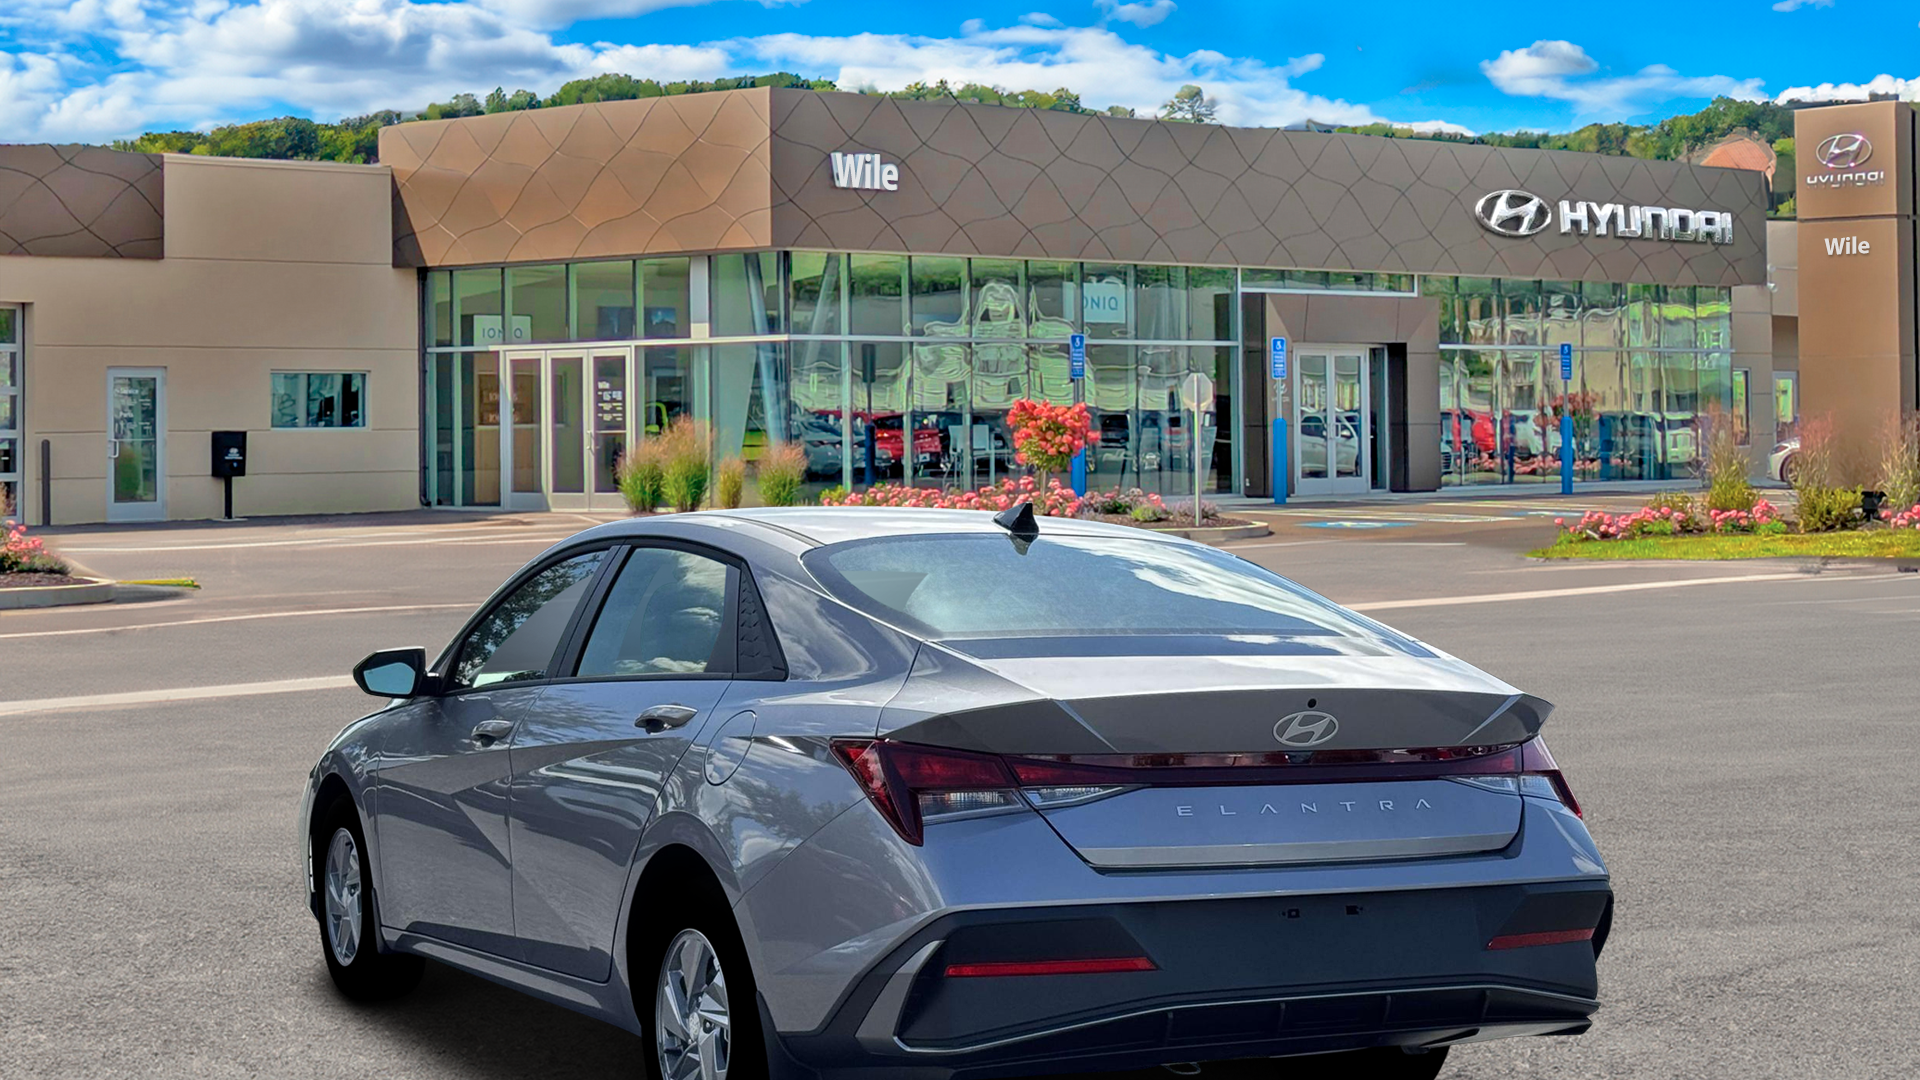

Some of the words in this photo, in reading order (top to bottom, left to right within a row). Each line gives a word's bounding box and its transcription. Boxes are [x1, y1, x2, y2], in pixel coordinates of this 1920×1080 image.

[830, 151, 899, 191] Wile
[1558, 199, 1735, 246] HYUNDAI
[1824, 235, 1871, 256] Wile
[1083, 296, 1119, 311] ONIQ
[481, 327, 523, 339] IONQ
[1176, 798, 1432, 817] ELANTRA
